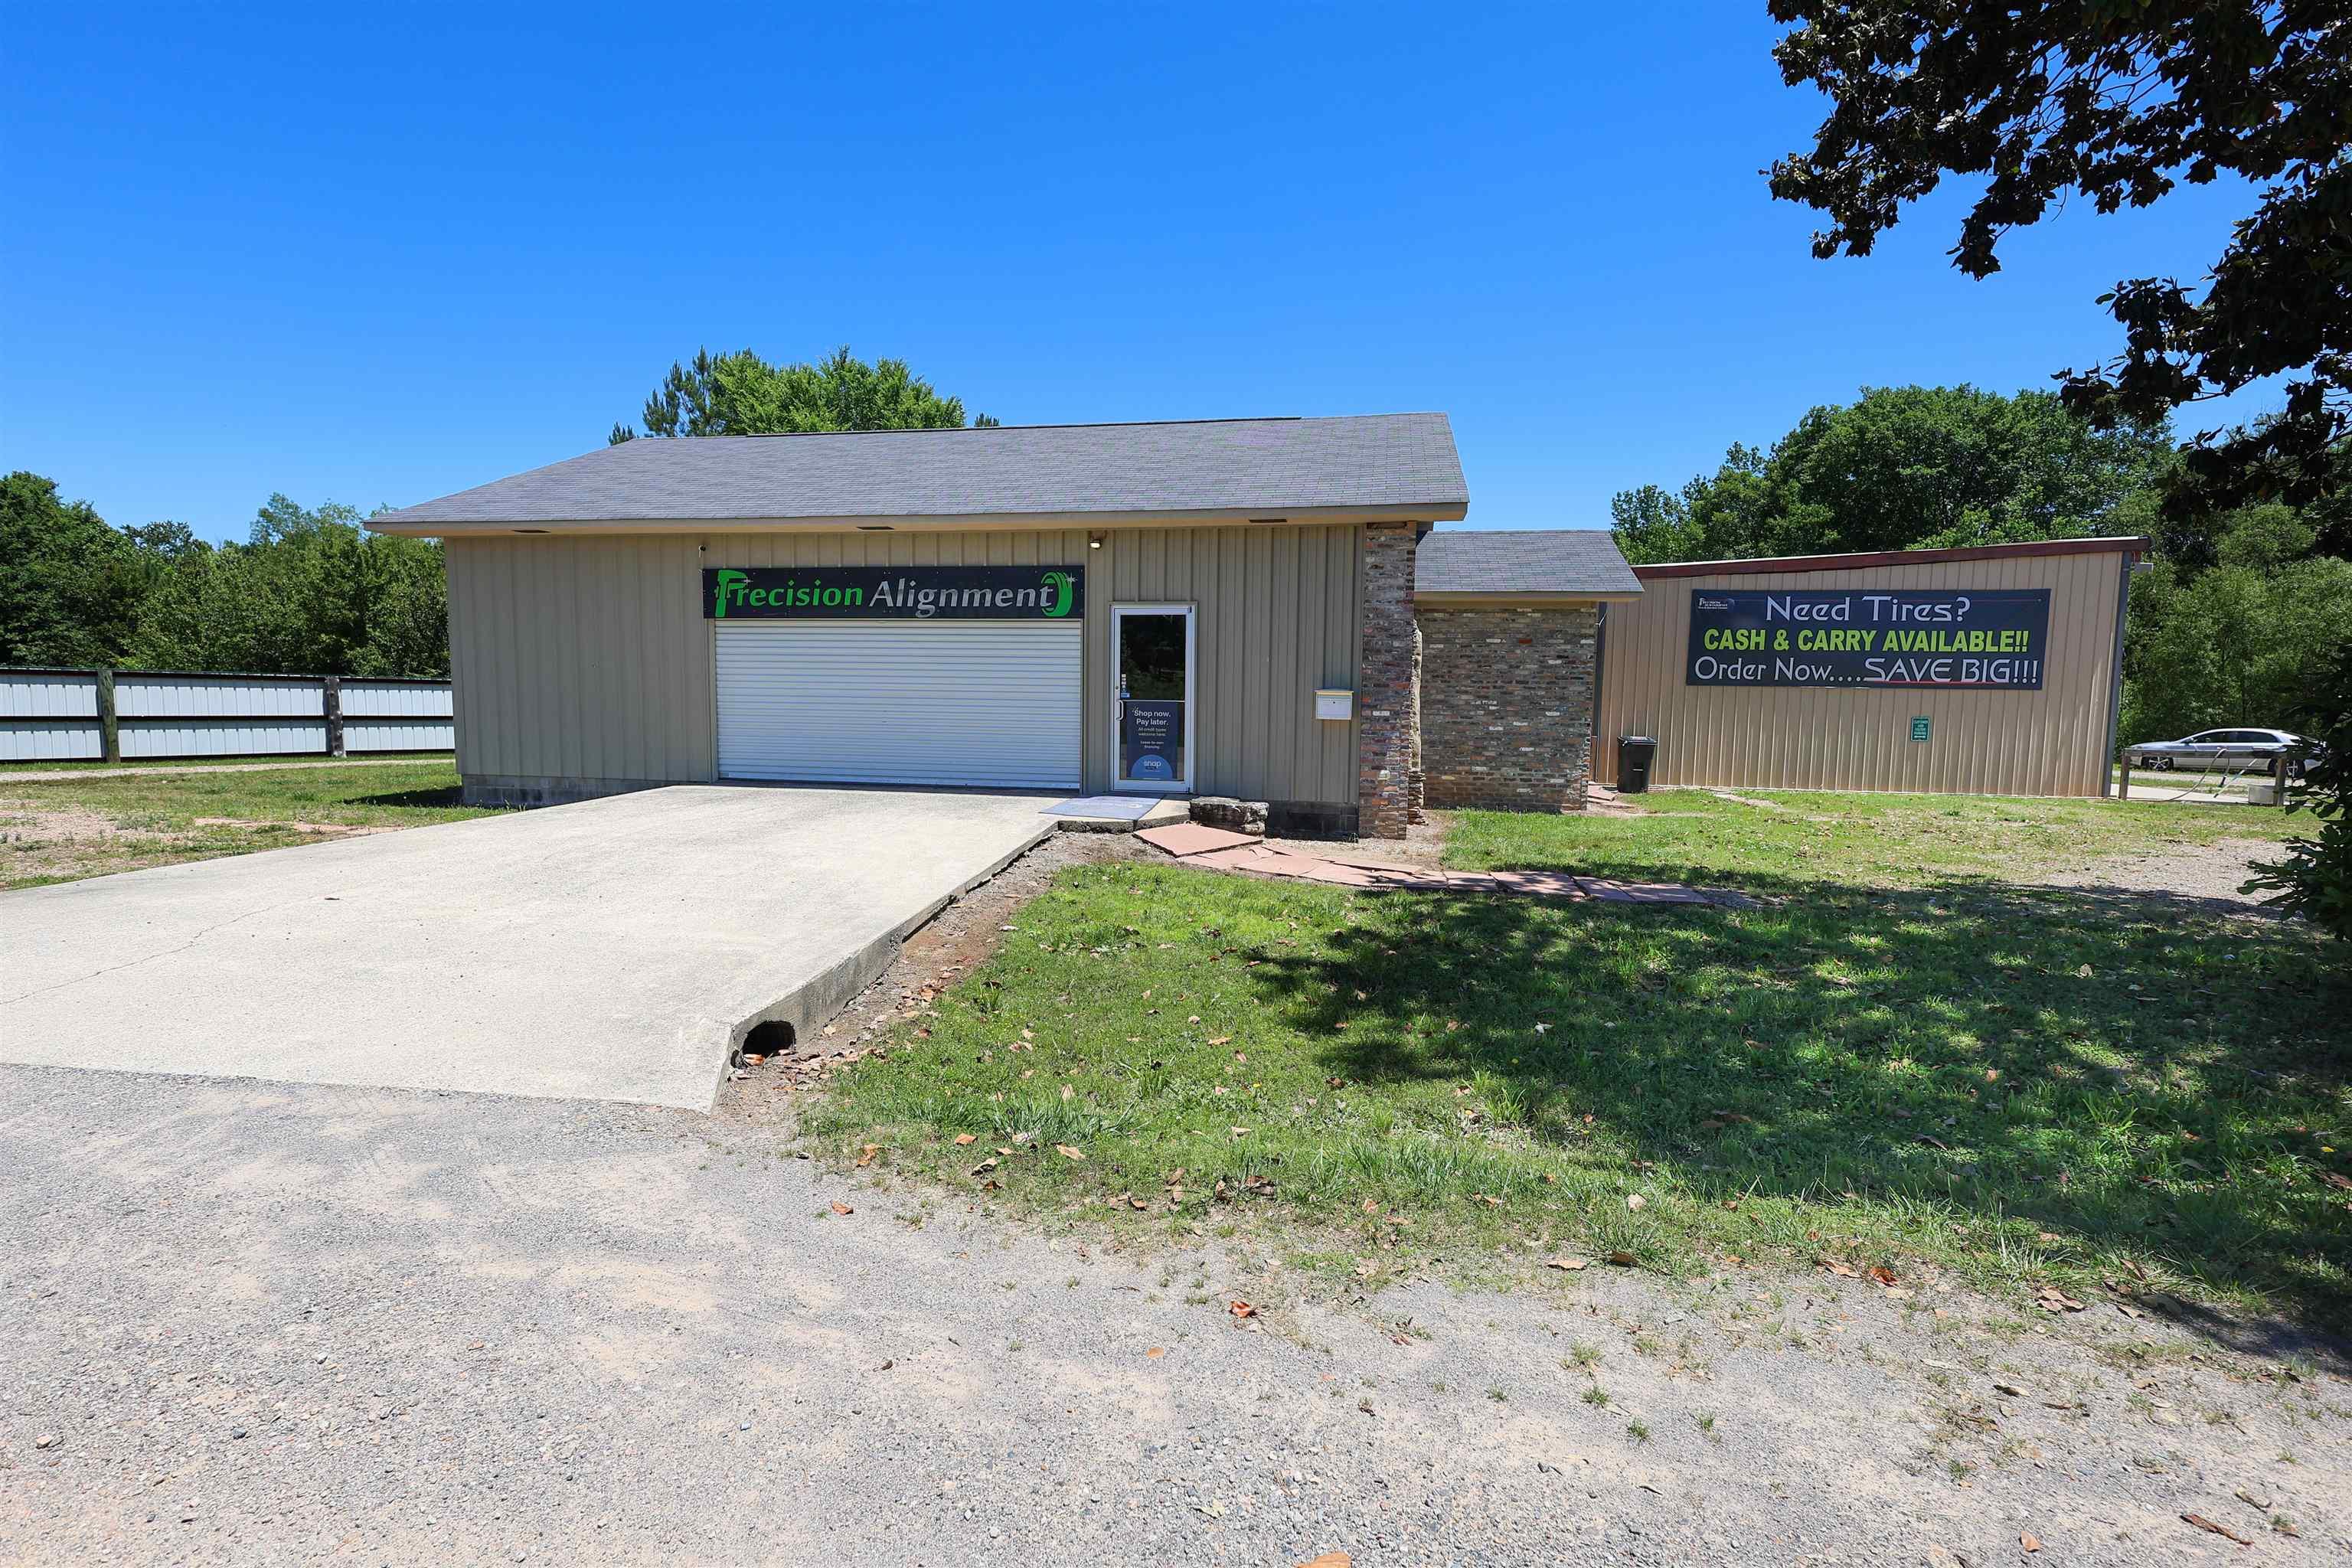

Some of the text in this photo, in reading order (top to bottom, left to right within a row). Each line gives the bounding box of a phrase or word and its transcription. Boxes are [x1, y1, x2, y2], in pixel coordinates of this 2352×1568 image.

[715, 570, 1054, 618] Precision Alignment
[1766, 596, 1971, 622] Need Tires?
[1704, 629, 2029, 652] CASH & CARRY AVAILABLE!!
[1695, 656, 1766, 680] Order
[1961, 659, 2038, 684] BIG!!!
[1136, 718, 1149, 727] Pay
